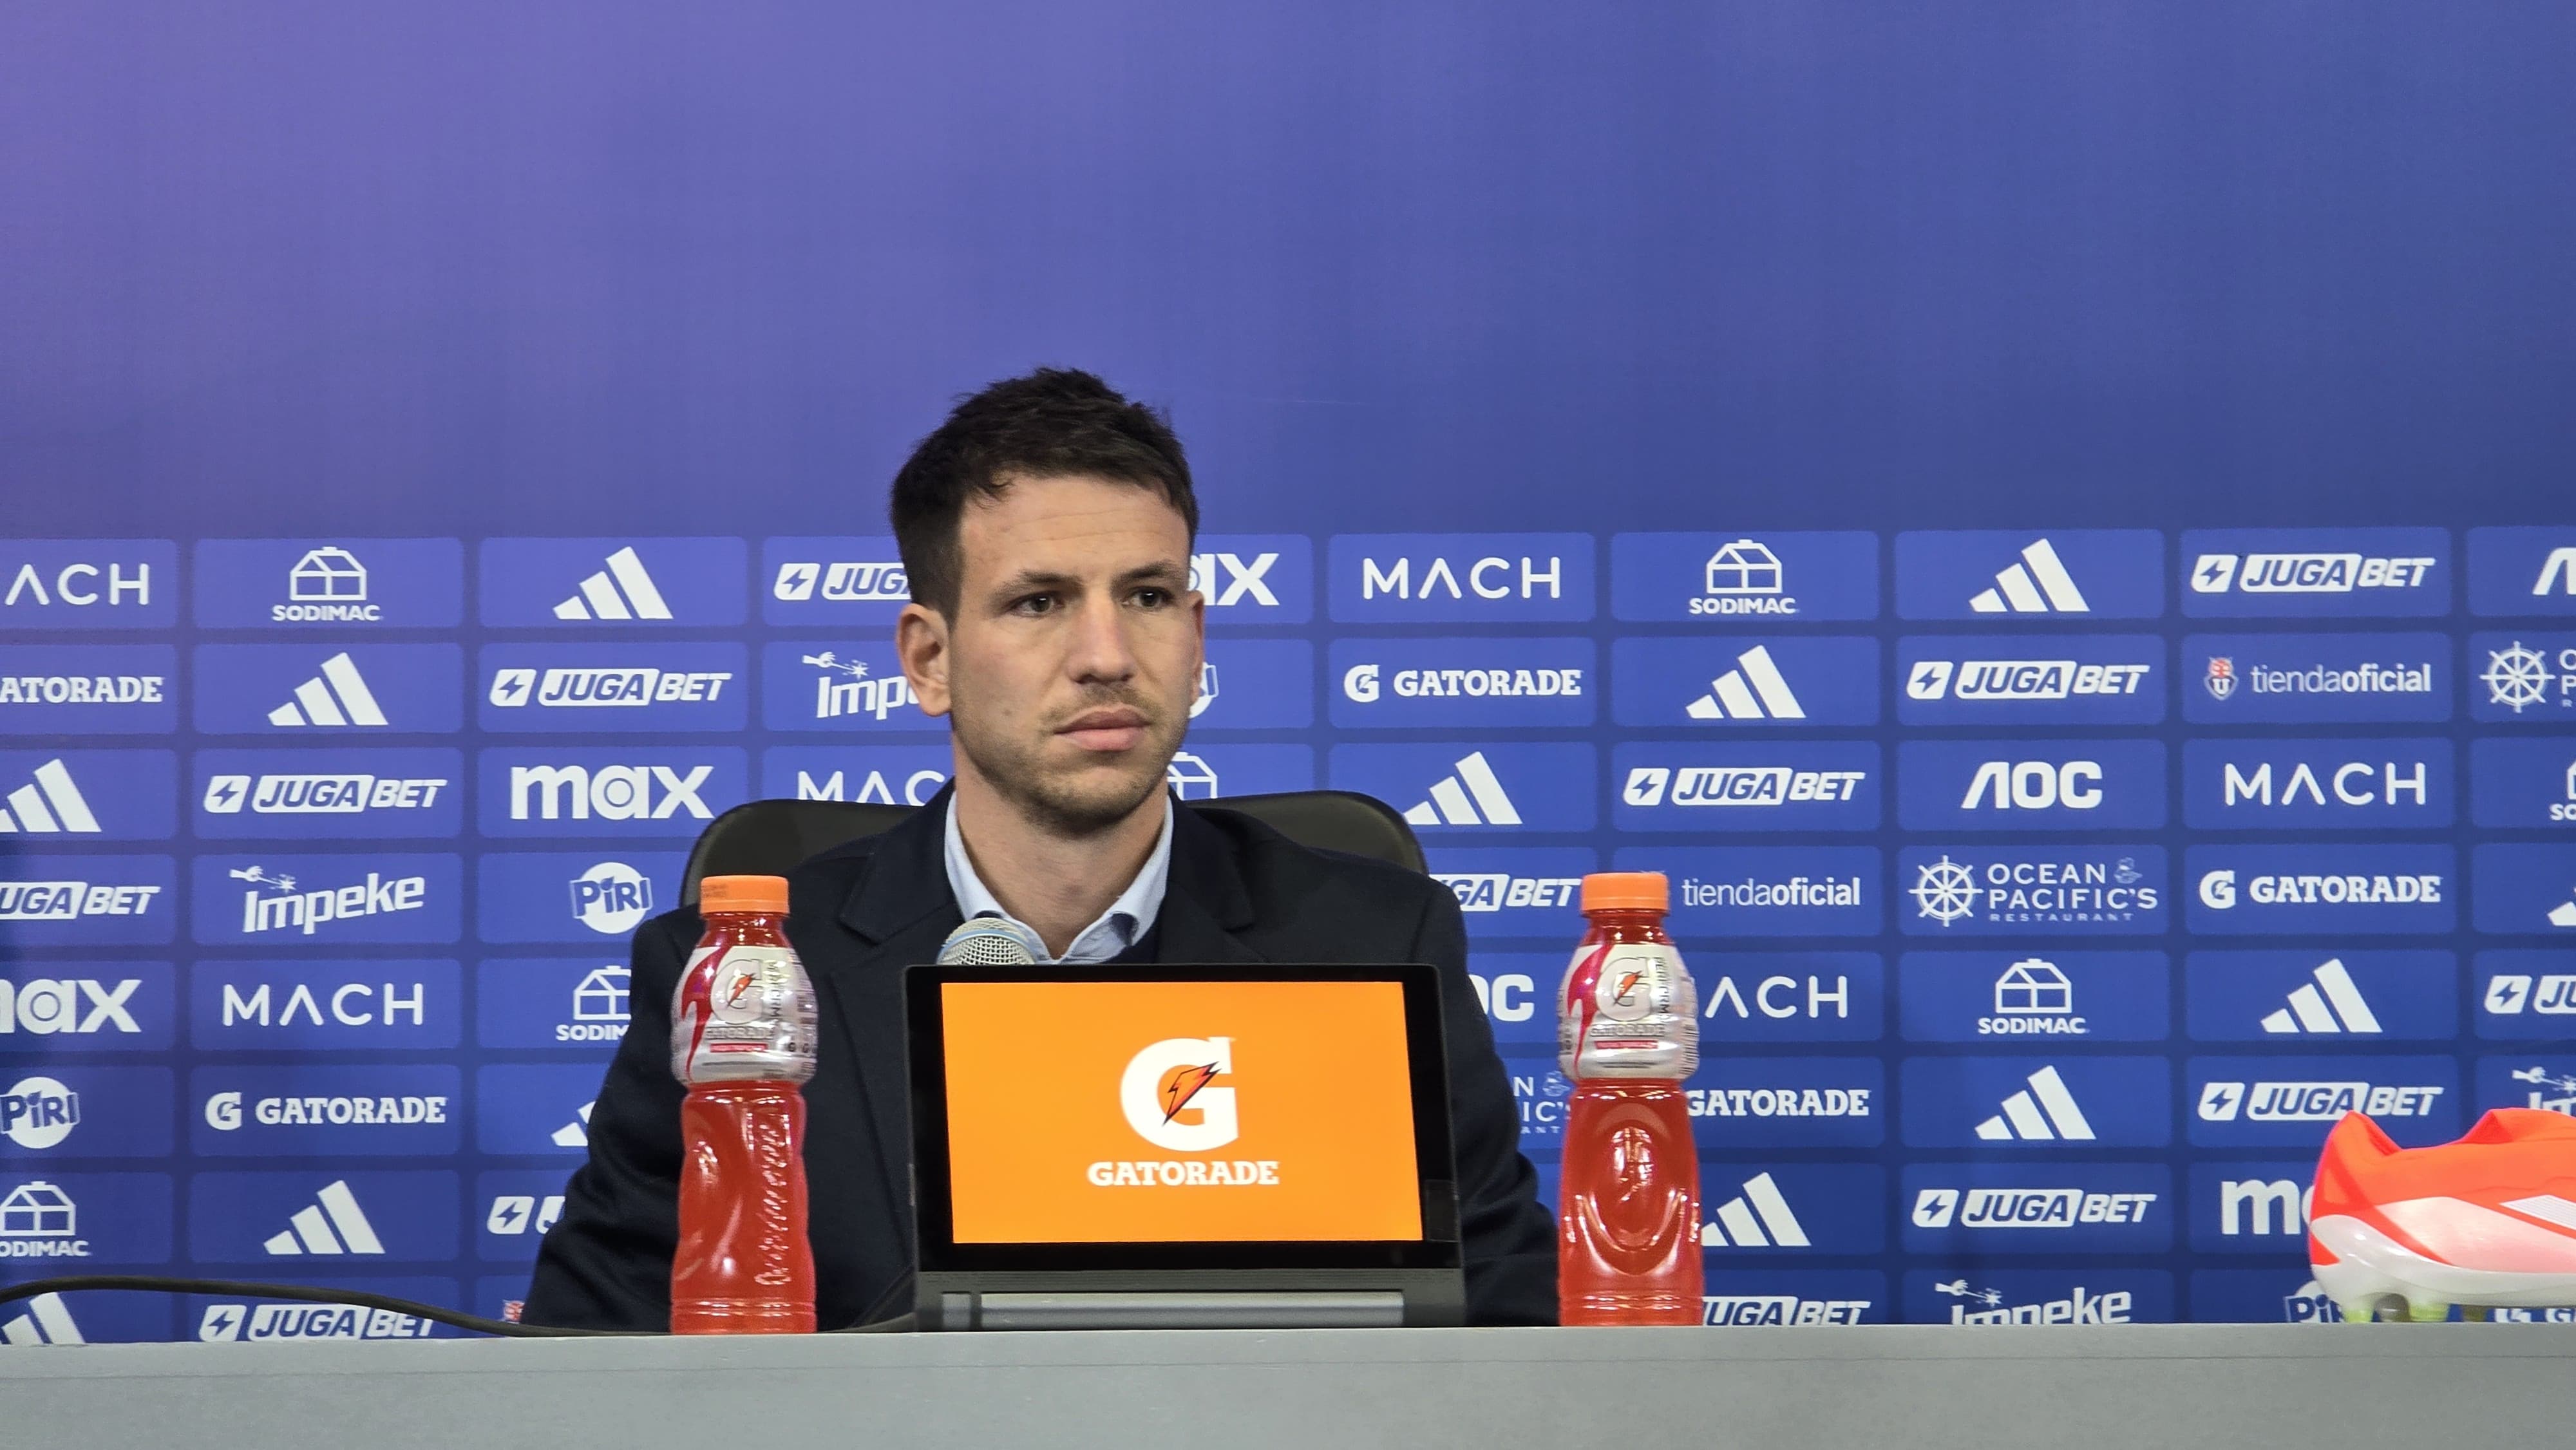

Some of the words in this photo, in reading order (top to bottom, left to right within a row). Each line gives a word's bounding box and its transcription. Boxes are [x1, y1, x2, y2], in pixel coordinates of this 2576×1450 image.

[5, 563, 149, 605] ACH
[1363, 556, 1560, 599] MACH
[2247, 557, 2436, 588] JUGABET
[272, 605, 380, 621] SODIMAC
[1689, 598, 1796, 614] SODIMAC
[0, 676, 164, 703] ATORADE
[545, 672, 732, 702] JUGABET
[1394, 669, 1582, 697] GATORADE
[1962, 664, 2151, 695] JUGABET
[2250, 663, 2431, 693] tiendaoficial
[817, 675, 920, 720] Imp
[259, 778, 448, 809] JUGABET
[511, 765, 715, 820] max
[798, 770, 945, 807] MAC
[1678, 772, 1866, 802] JUGABET
[1961, 761, 2103, 809] AOC
[2224, 762, 2425, 806] MACH
[1987, 863, 2106, 885] OCEAN
[0, 885, 162, 915] UGABET
[242, 872, 425, 935] Impeke
[1450, 878, 1582, 907] GABET
[1681, 877, 1861, 906] tiendaoficial
[1989, 888, 2157, 910] PACIFIC'S
[2249, 876, 2441, 903] GATORADE
[1989, 912, 2132, 922] RESTAURANT
[0, 979, 142, 1034] ax
[223, 983, 423, 1026] MACH
[1705, 975, 1848, 1019] ACH
[1978, 1017, 2087, 1034] SODIMAC
[1121, 1036, 1240, 1151] G
[1685, 1089, 1870, 1117] GATORADE
[2254, 1086, 2445, 1116] JUGABET
[256, 1097, 448, 1124] GATORADE
[1088, 1160, 1279, 1187] GATORADE
[1967, 1193, 2157, 1223] JUGABET
[0, 1240, 90, 1257] ODIMAC
[1704, 1301, 1871, 1326] UGABET
